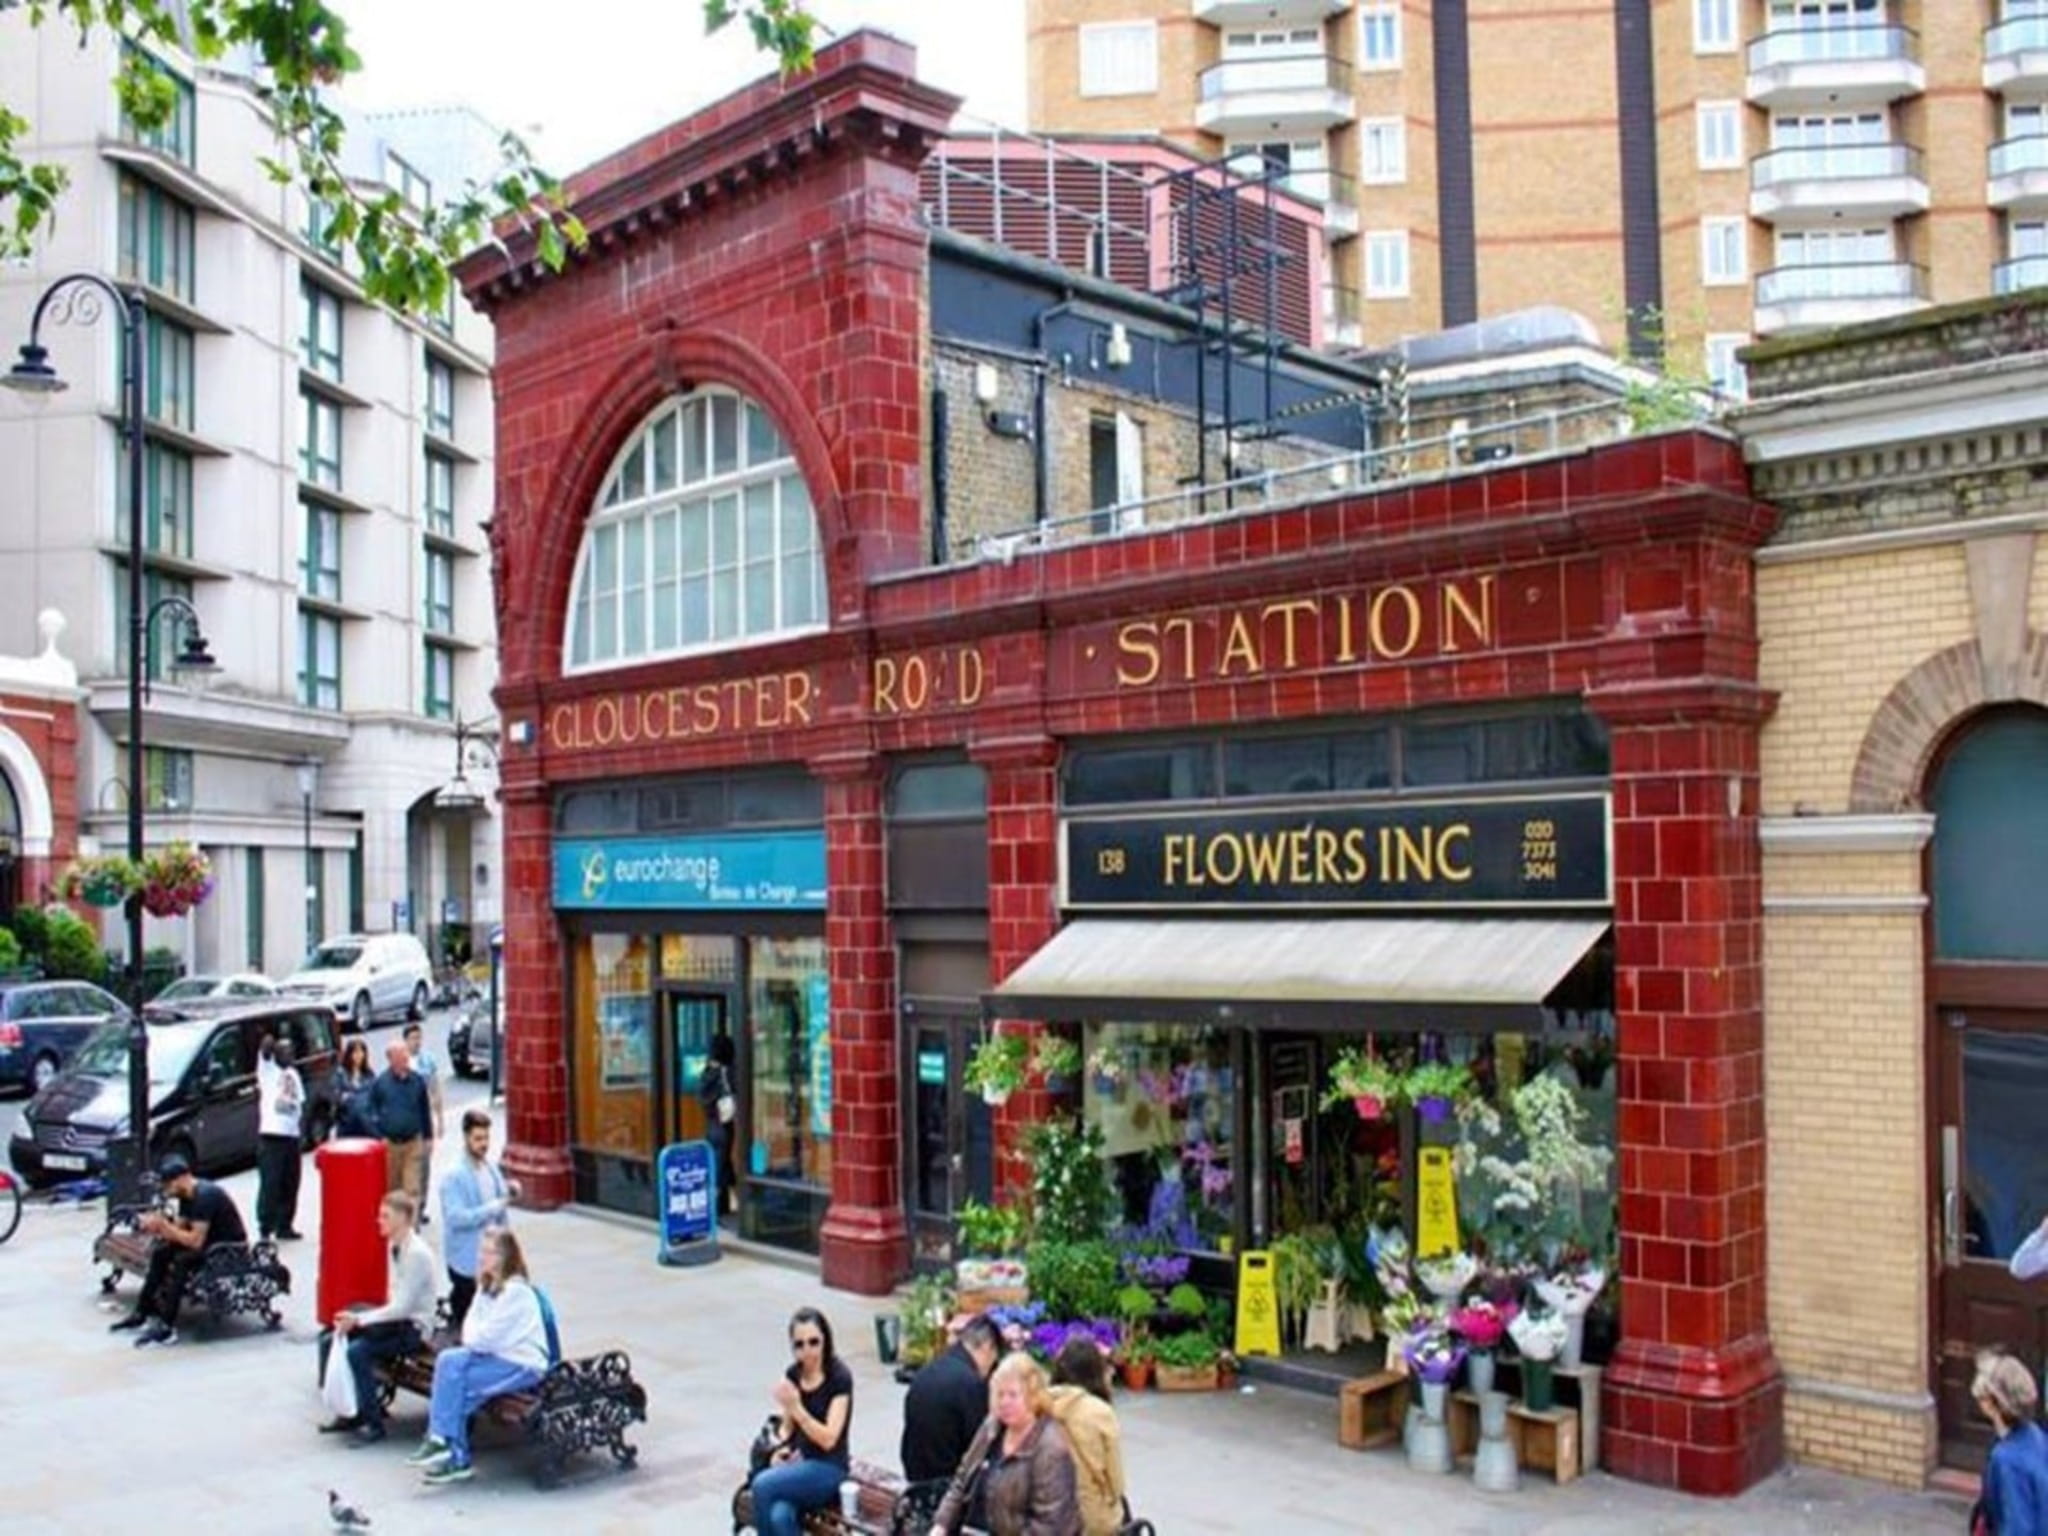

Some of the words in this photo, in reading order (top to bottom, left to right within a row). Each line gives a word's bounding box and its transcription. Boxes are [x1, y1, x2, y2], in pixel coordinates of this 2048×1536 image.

[552, 670, 812, 751] GLOUCESTER
[874, 649, 983, 714] ROD
[1116, 574, 1495, 686] STATION
[613, 852, 721, 891] eurochange
[1098, 849, 1126, 875] 138
[1164, 825, 1367, 887] FLOWERS
[1379, 823, 1472, 883] INC
